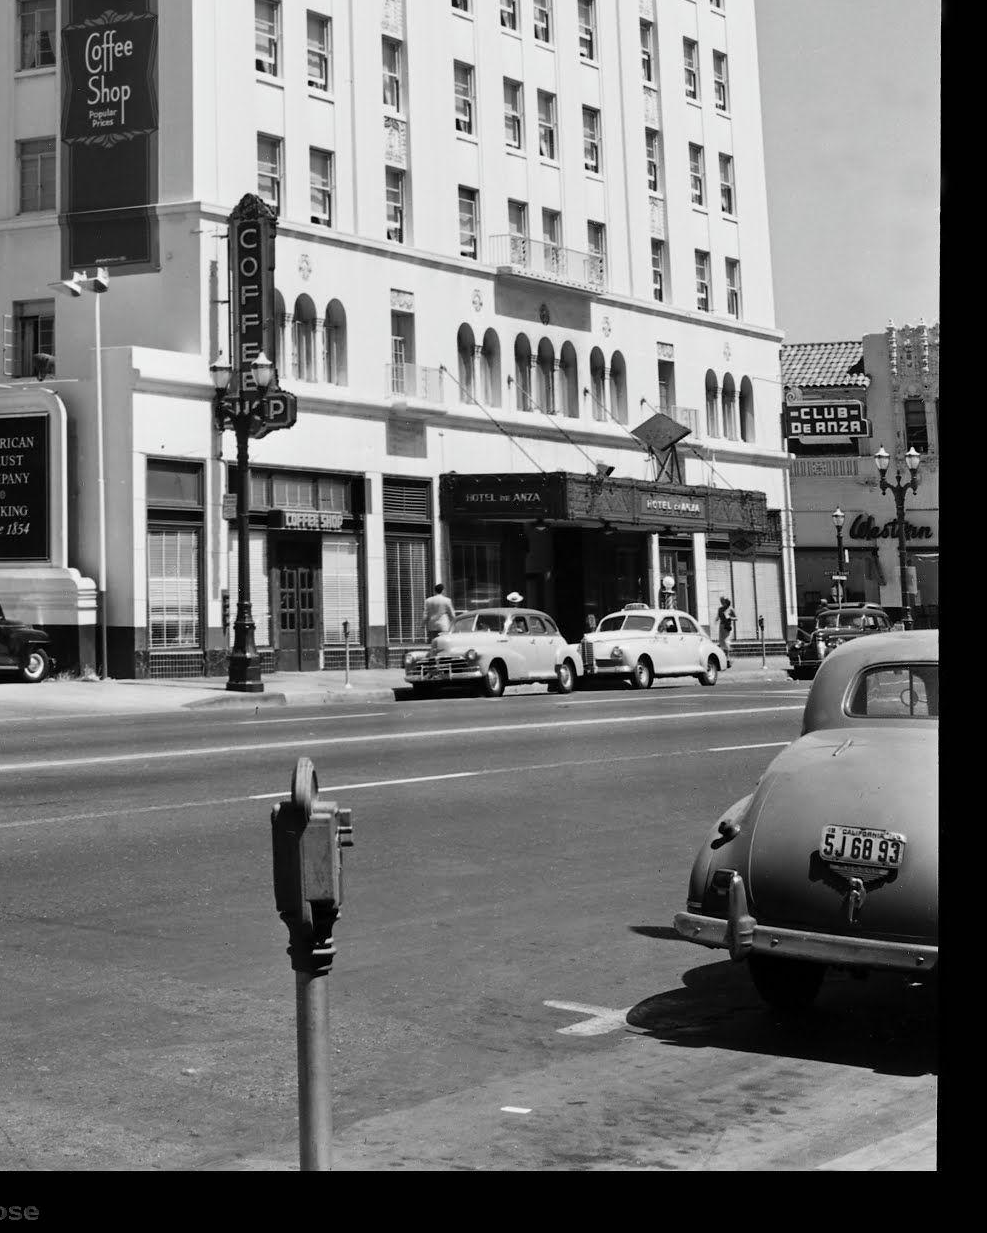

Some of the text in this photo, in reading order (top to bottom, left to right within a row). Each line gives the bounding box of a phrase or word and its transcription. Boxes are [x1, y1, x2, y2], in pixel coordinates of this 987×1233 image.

[85, 29, 133, 74] Coffee
[87, 74, 131, 125] Shop
[89, 108, 118, 120] Popular
[92, 118, 115, 128] Prices
[239, 228, 261, 392] COFFEE
[800, 407, 848, 420] CLUB
[815, 420, 861, 433] ANZA
[466, 493, 497, 502] HOTEL
[513, 492, 541, 502] ANZA
[646, 499, 672, 510] HOTEL
[681, 502, 700, 512] ANZA
[285, 512, 343, 529] COFFEE SHOP
[6, 521, 31, 535] 1854
